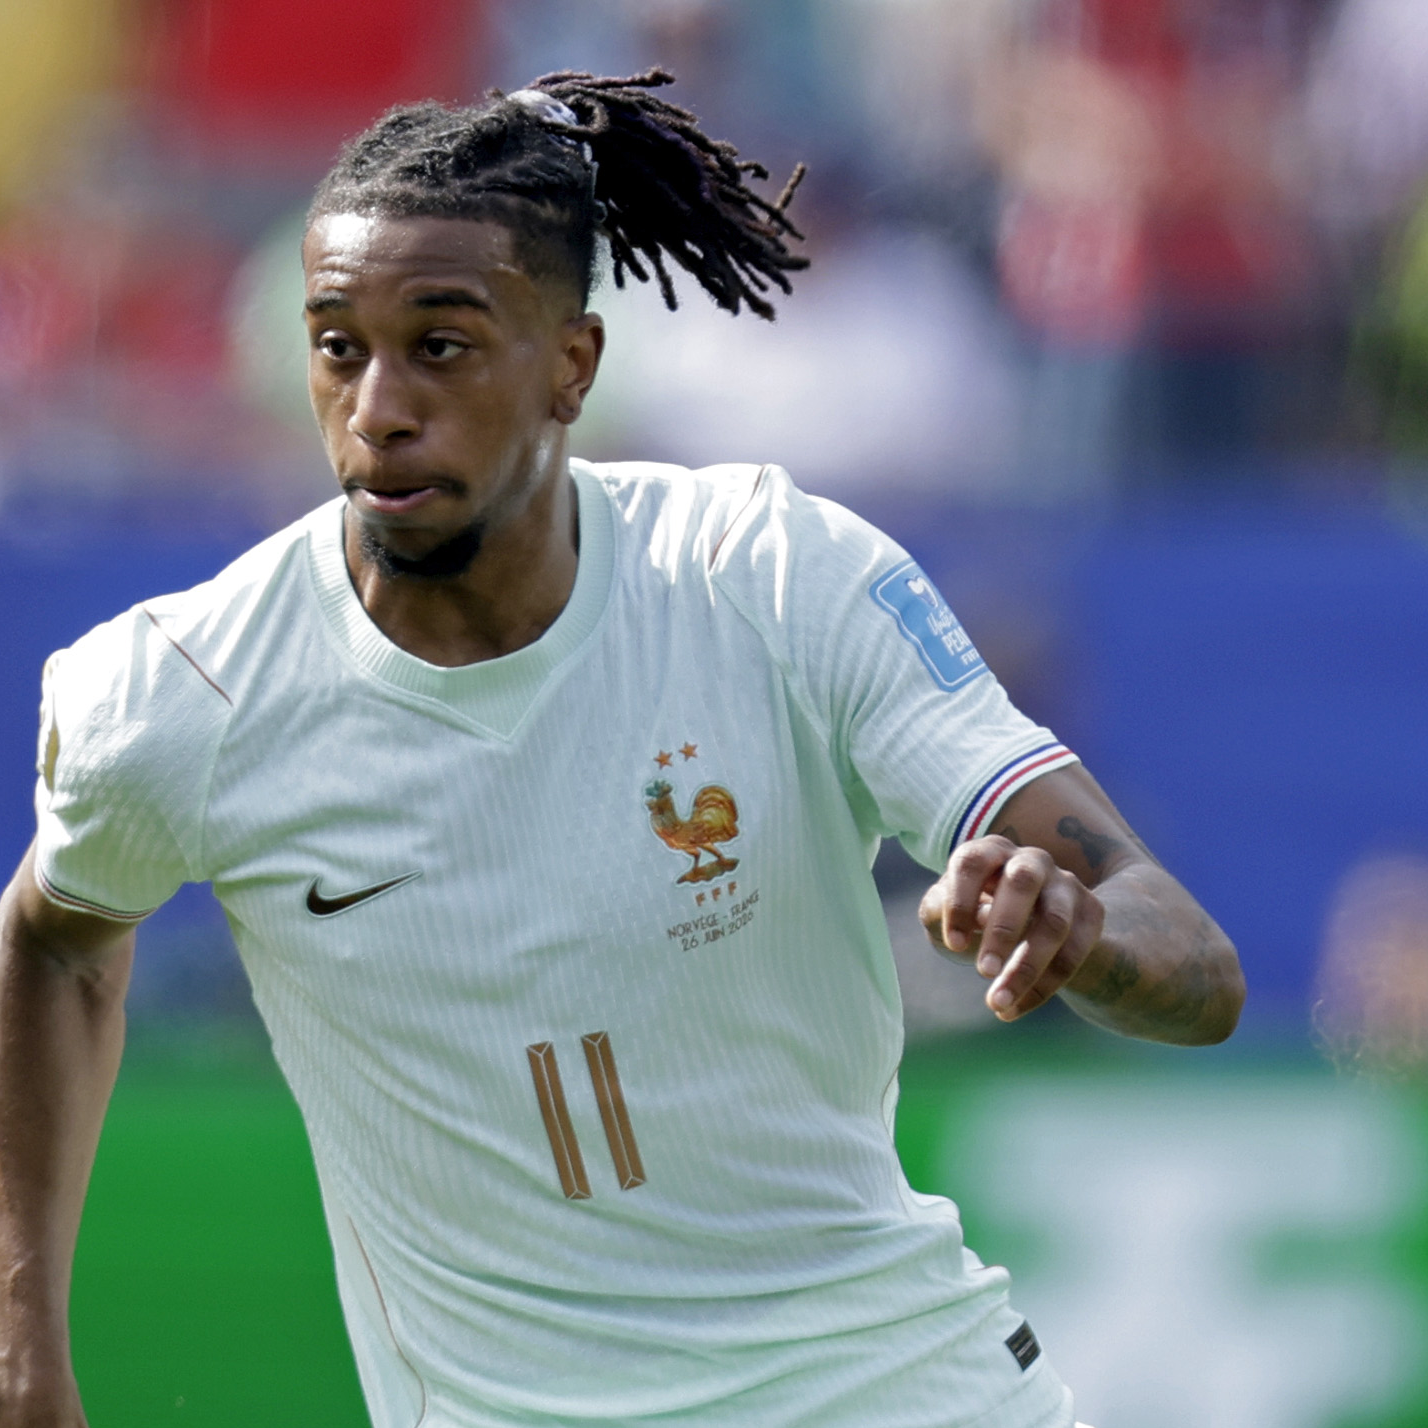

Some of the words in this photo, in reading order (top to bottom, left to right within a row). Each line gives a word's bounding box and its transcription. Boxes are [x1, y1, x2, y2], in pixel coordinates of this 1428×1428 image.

[942, 626, 972, 656] PEA
[681, 935, 699, 951] 26
[526, 1030, 646, 1200] 11
